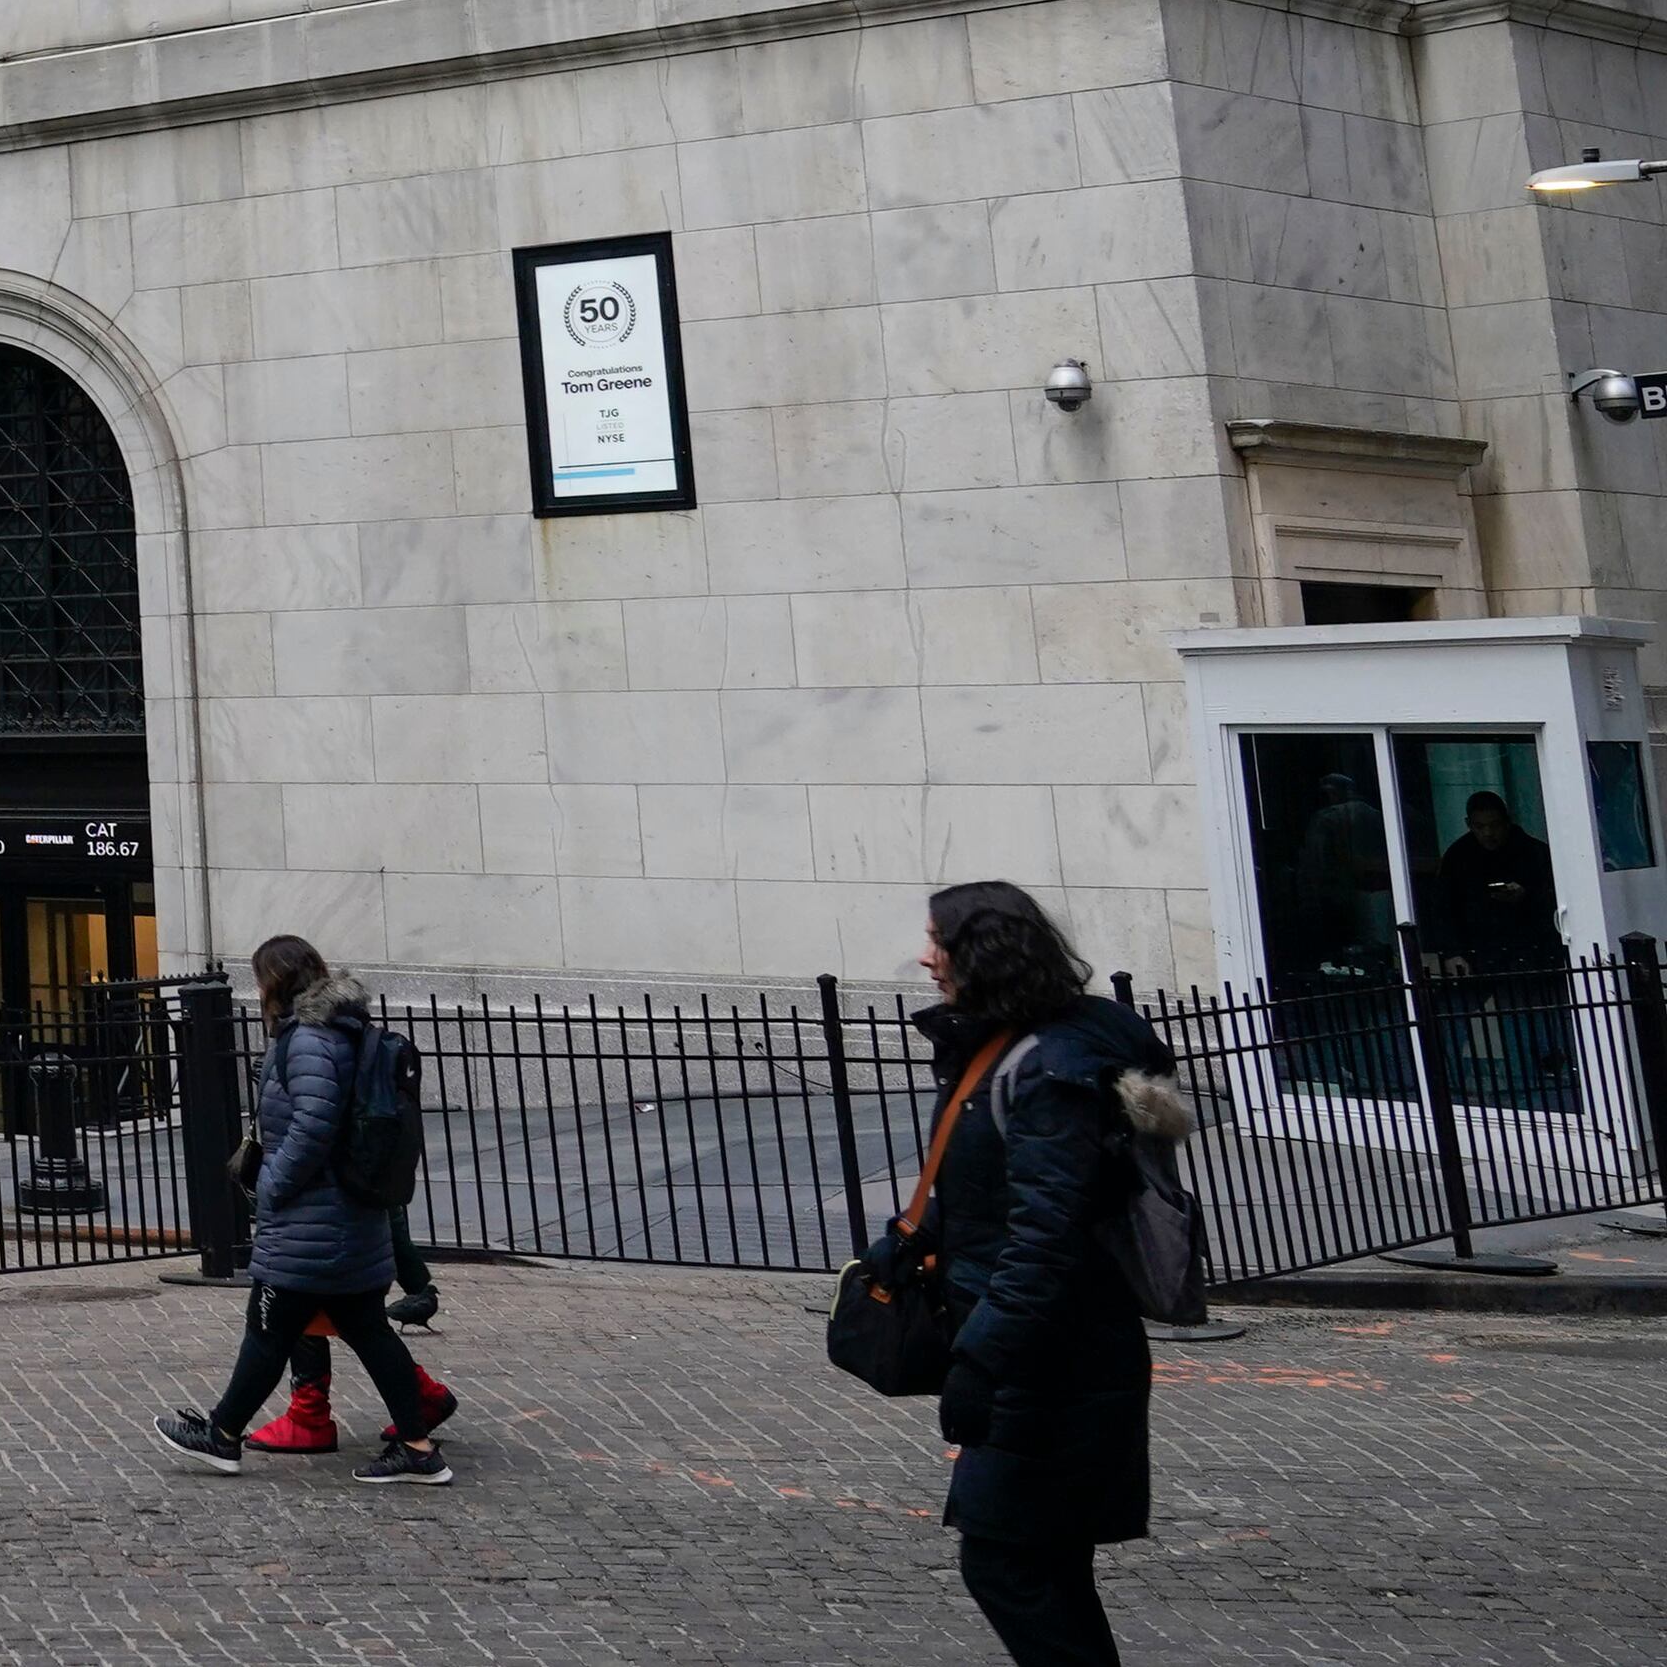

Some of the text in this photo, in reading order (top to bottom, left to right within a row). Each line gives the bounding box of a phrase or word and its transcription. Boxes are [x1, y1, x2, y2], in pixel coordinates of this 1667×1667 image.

[580, 296, 620, 323] 50
[584, 322, 618, 334] YEARS
[568, 365, 643, 378] Congratulations
[561, 377, 652, 395] Tom Greene
[1642, 385, 1667, 411] B
[599, 408, 619, 418] TJG
[597, 433, 625, 444] NYSE
[85, 822, 117, 838] CAT
[25, 834, 74, 845] CATERPILLAR
[87, 841, 139, 856] 186.67
